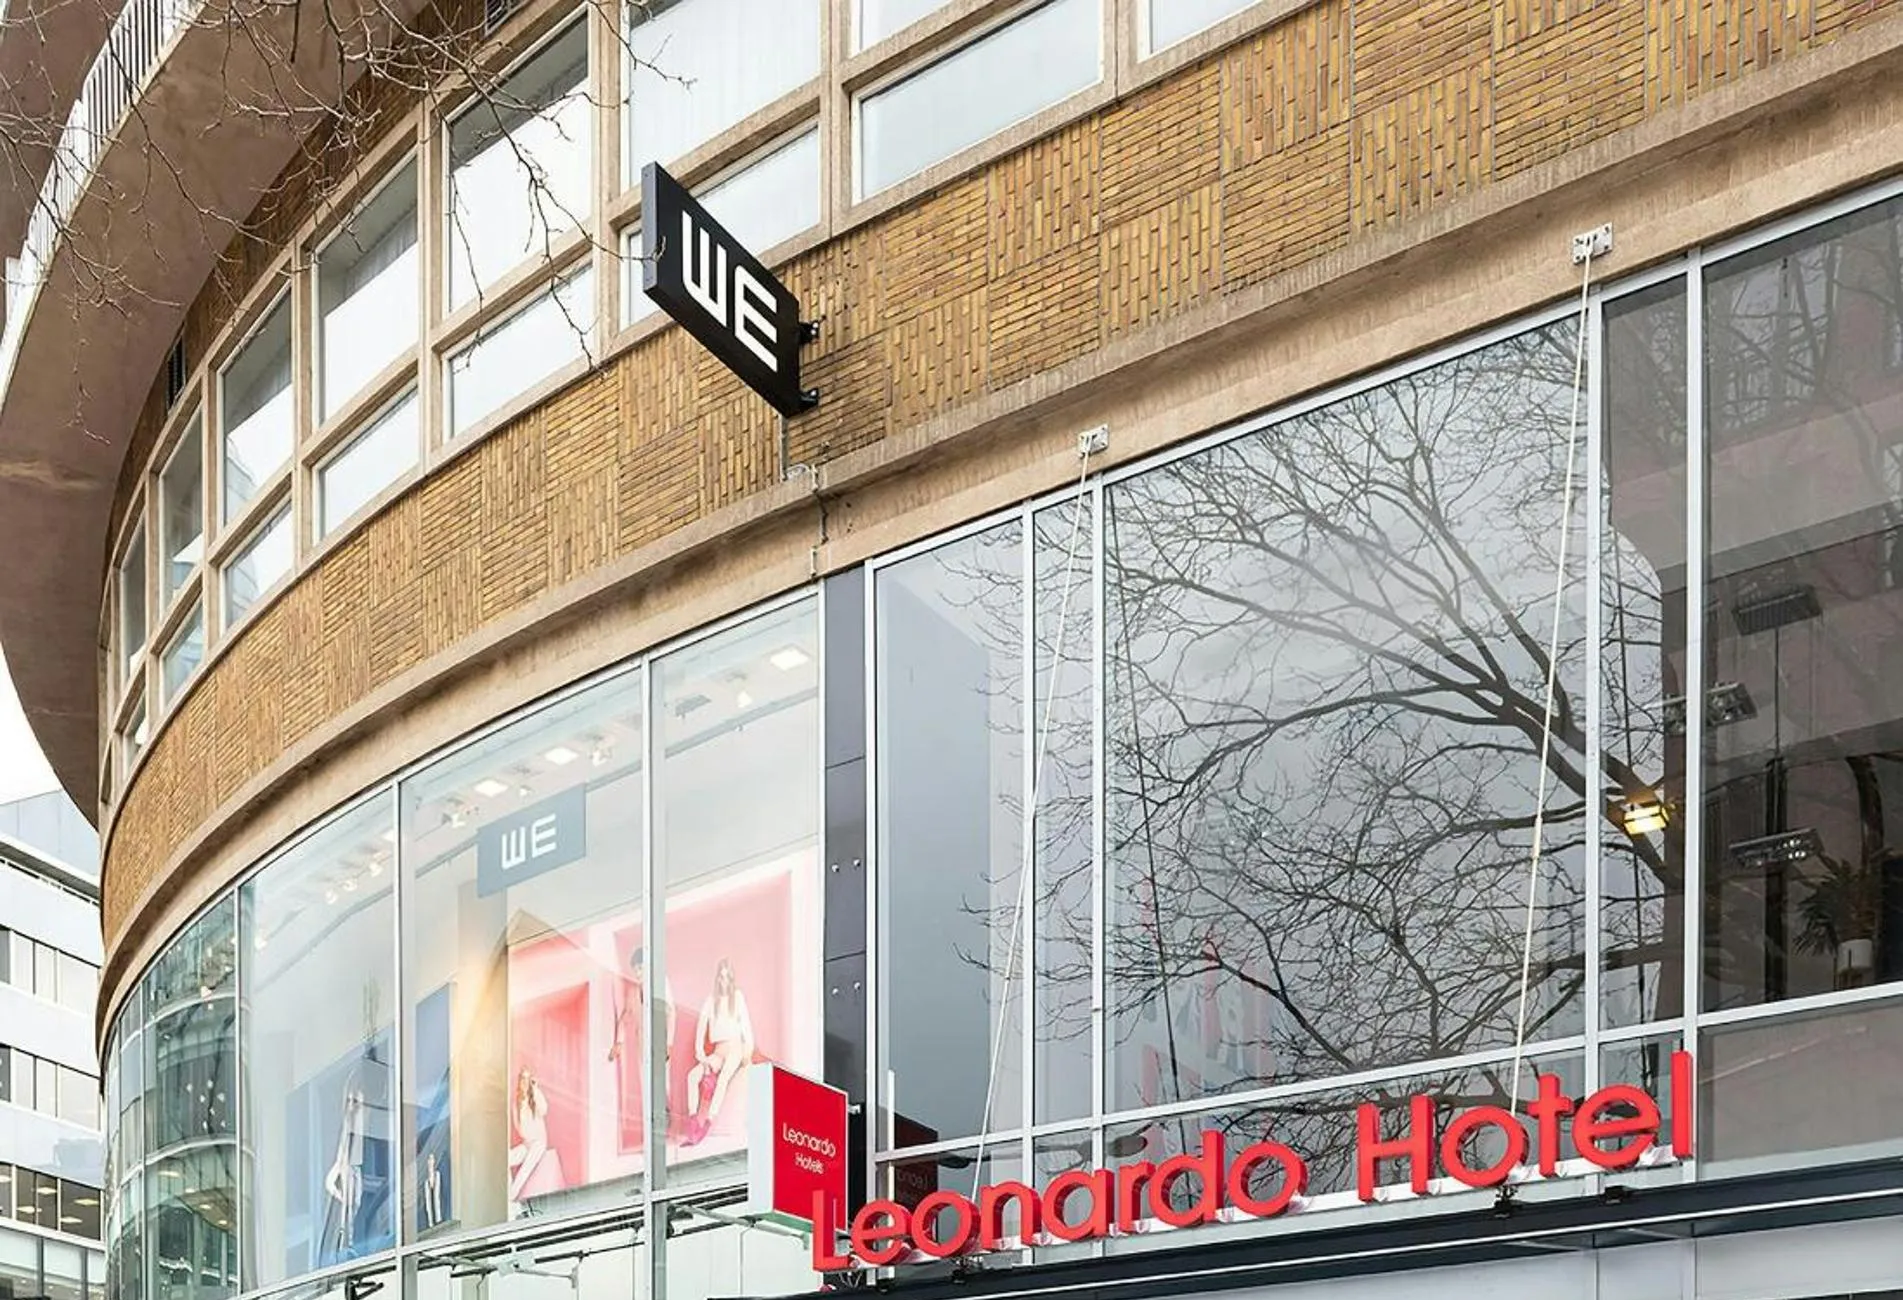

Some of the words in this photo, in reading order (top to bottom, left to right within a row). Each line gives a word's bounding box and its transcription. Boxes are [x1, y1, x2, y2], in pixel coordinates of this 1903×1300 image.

[682, 210, 777, 374] WE
[501, 813, 556, 870] WE
[782, 1121, 837, 1159] Leonardo
[795, 1152, 825, 1175] Hotels
[813, 1129, 1308, 1272] Leonardo
[1356, 1050, 1694, 1203] Hotel
